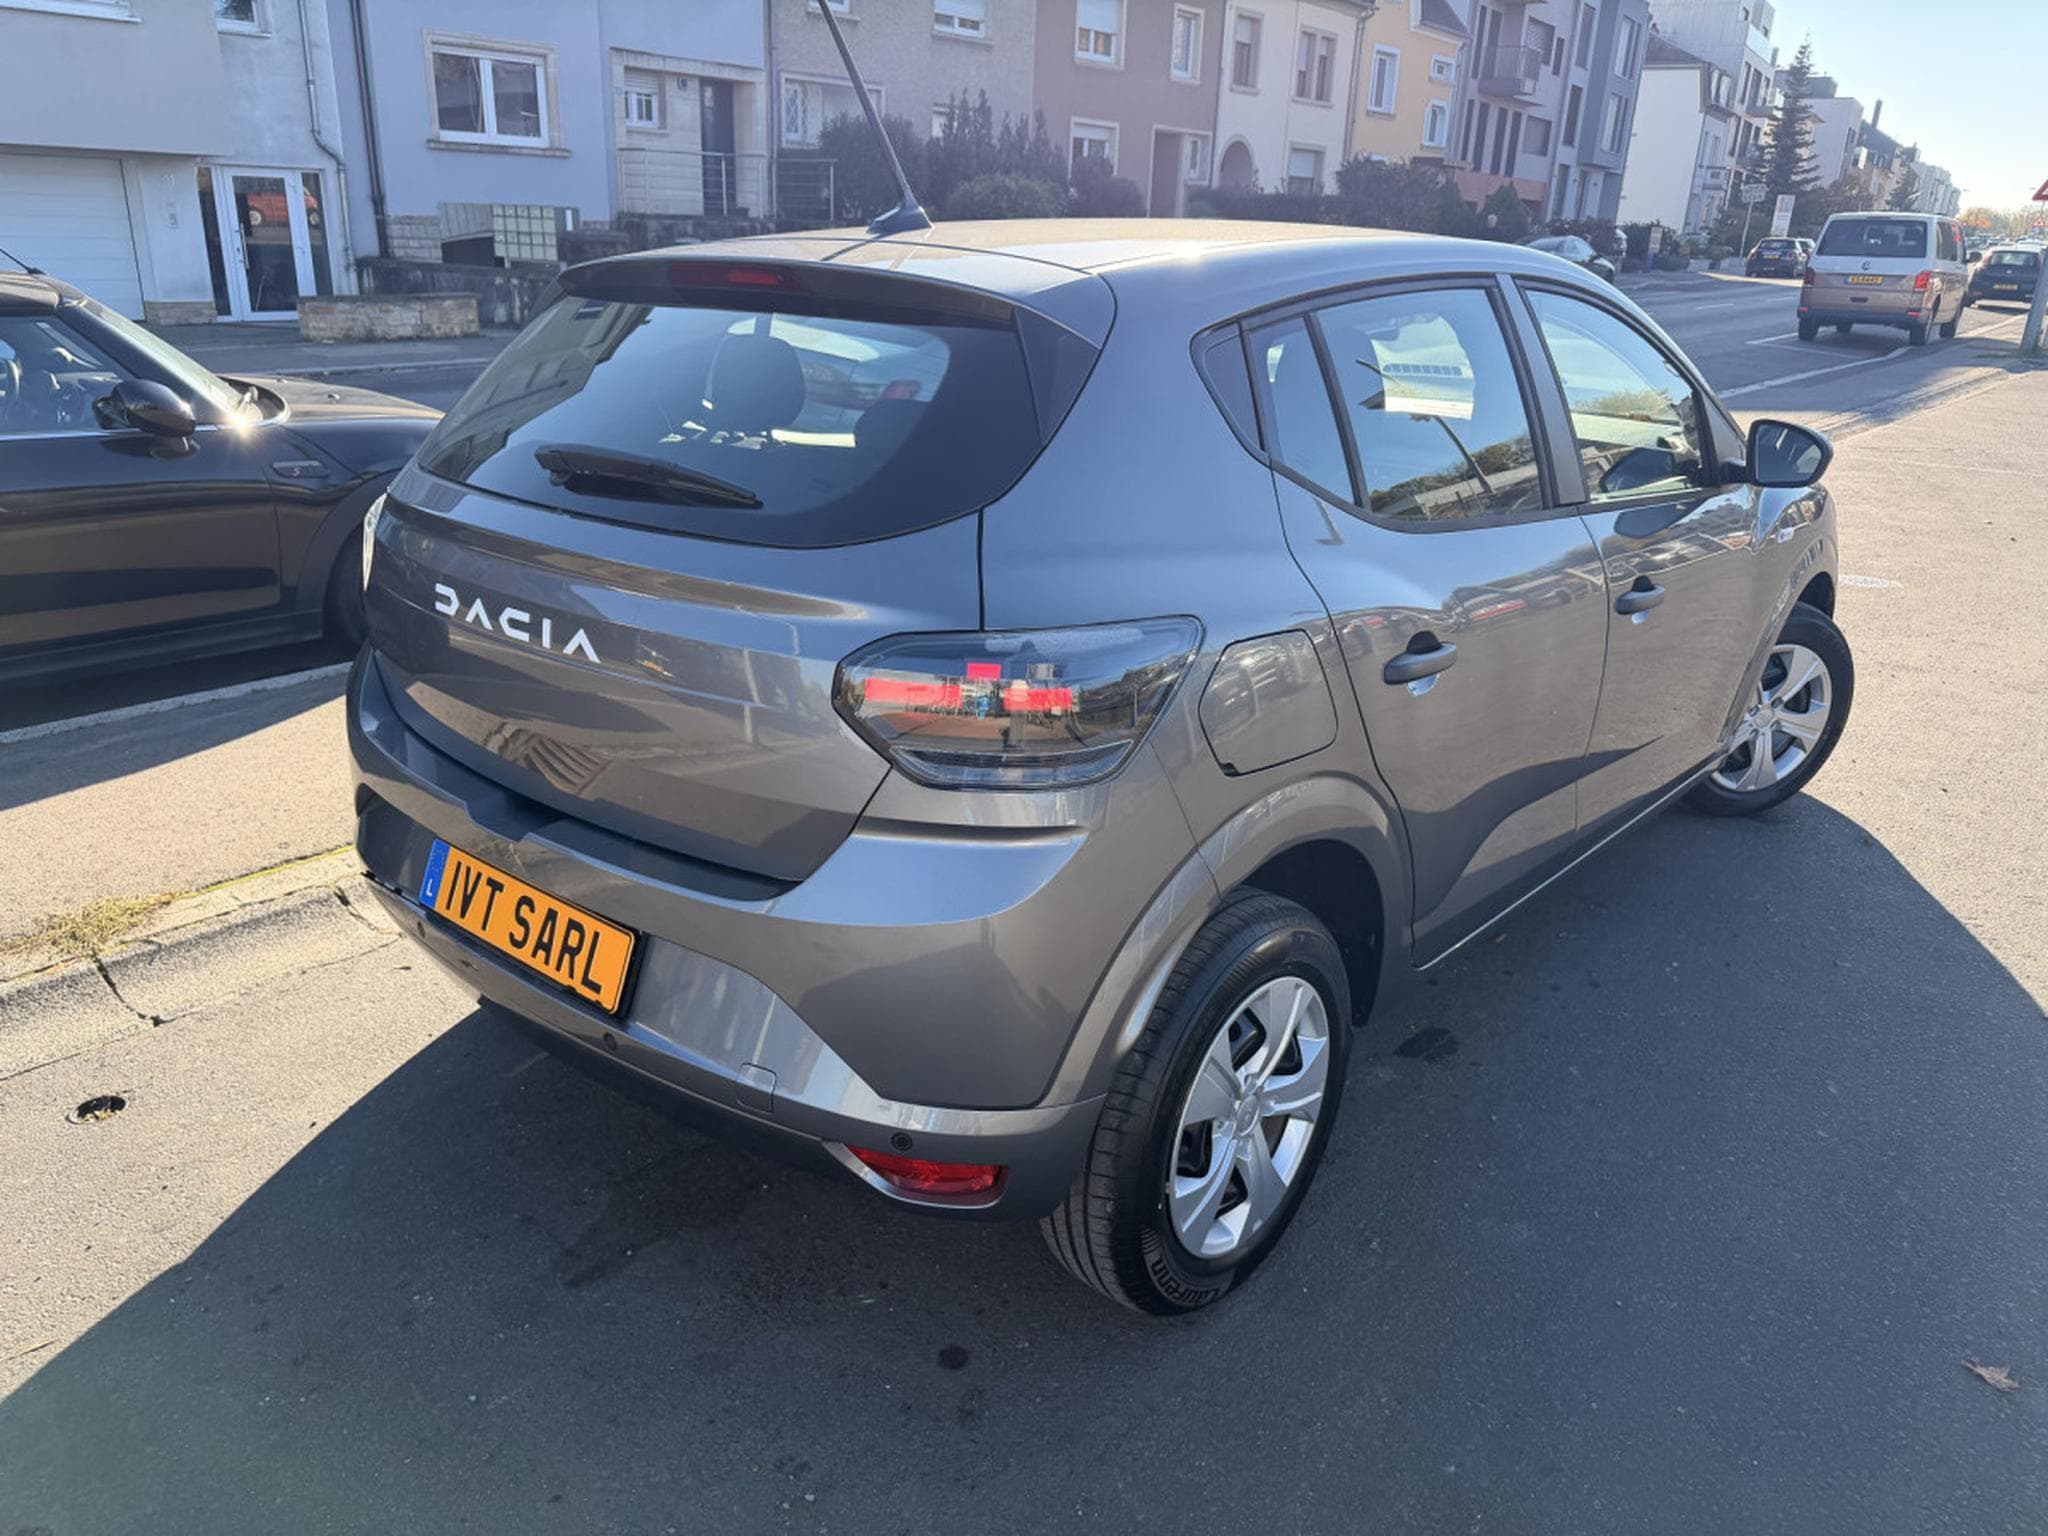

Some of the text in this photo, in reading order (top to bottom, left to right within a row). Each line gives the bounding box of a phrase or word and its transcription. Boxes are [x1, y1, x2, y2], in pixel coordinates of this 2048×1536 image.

[434, 583, 601, 664] DACIA
[445, 860, 602, 996] IVT SARL
